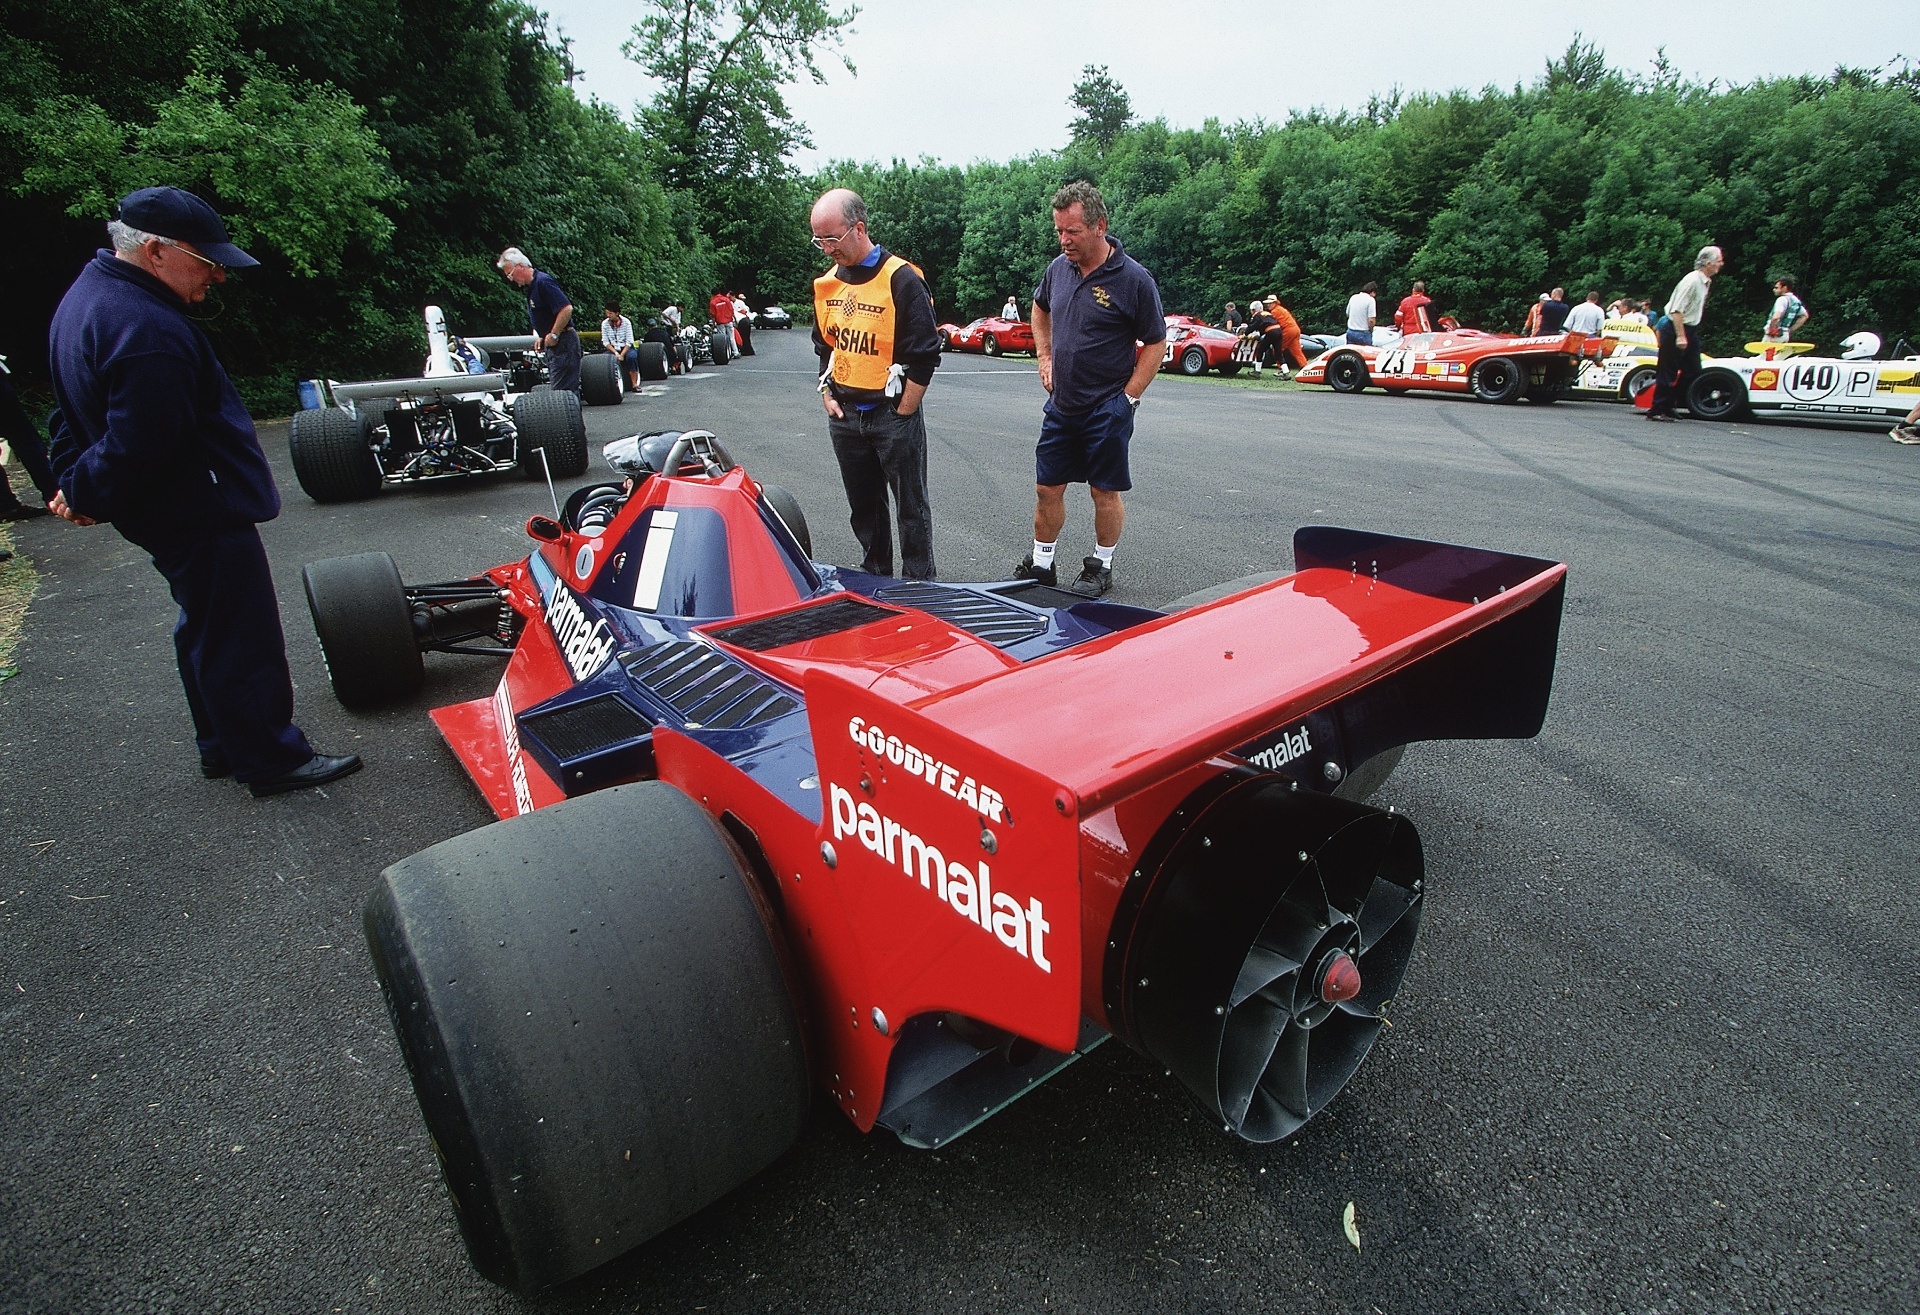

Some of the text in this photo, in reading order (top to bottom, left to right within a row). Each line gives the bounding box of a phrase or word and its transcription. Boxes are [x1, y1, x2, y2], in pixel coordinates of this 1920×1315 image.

[827, 324, 879, 356] RSHAL
[1603, 322, 1643, 333] Renault
[1302, 369, 1324, 377] Shell
[1381, 350, 1408, 374] 23
[1386, 373, 1448, 382] PORSCHE
[1791, 365, 1834, 391] 140
[1851, 371, 1870, 393] P
[1780, 404, 1887, 414] PORSCHE
[544, 576, 617, 682] parmalat
[1248, 725, 1313, 769] malat
[849, 716, 1004, 824] GOODYEAR
[829, 781, 1052, 974] parmalat
